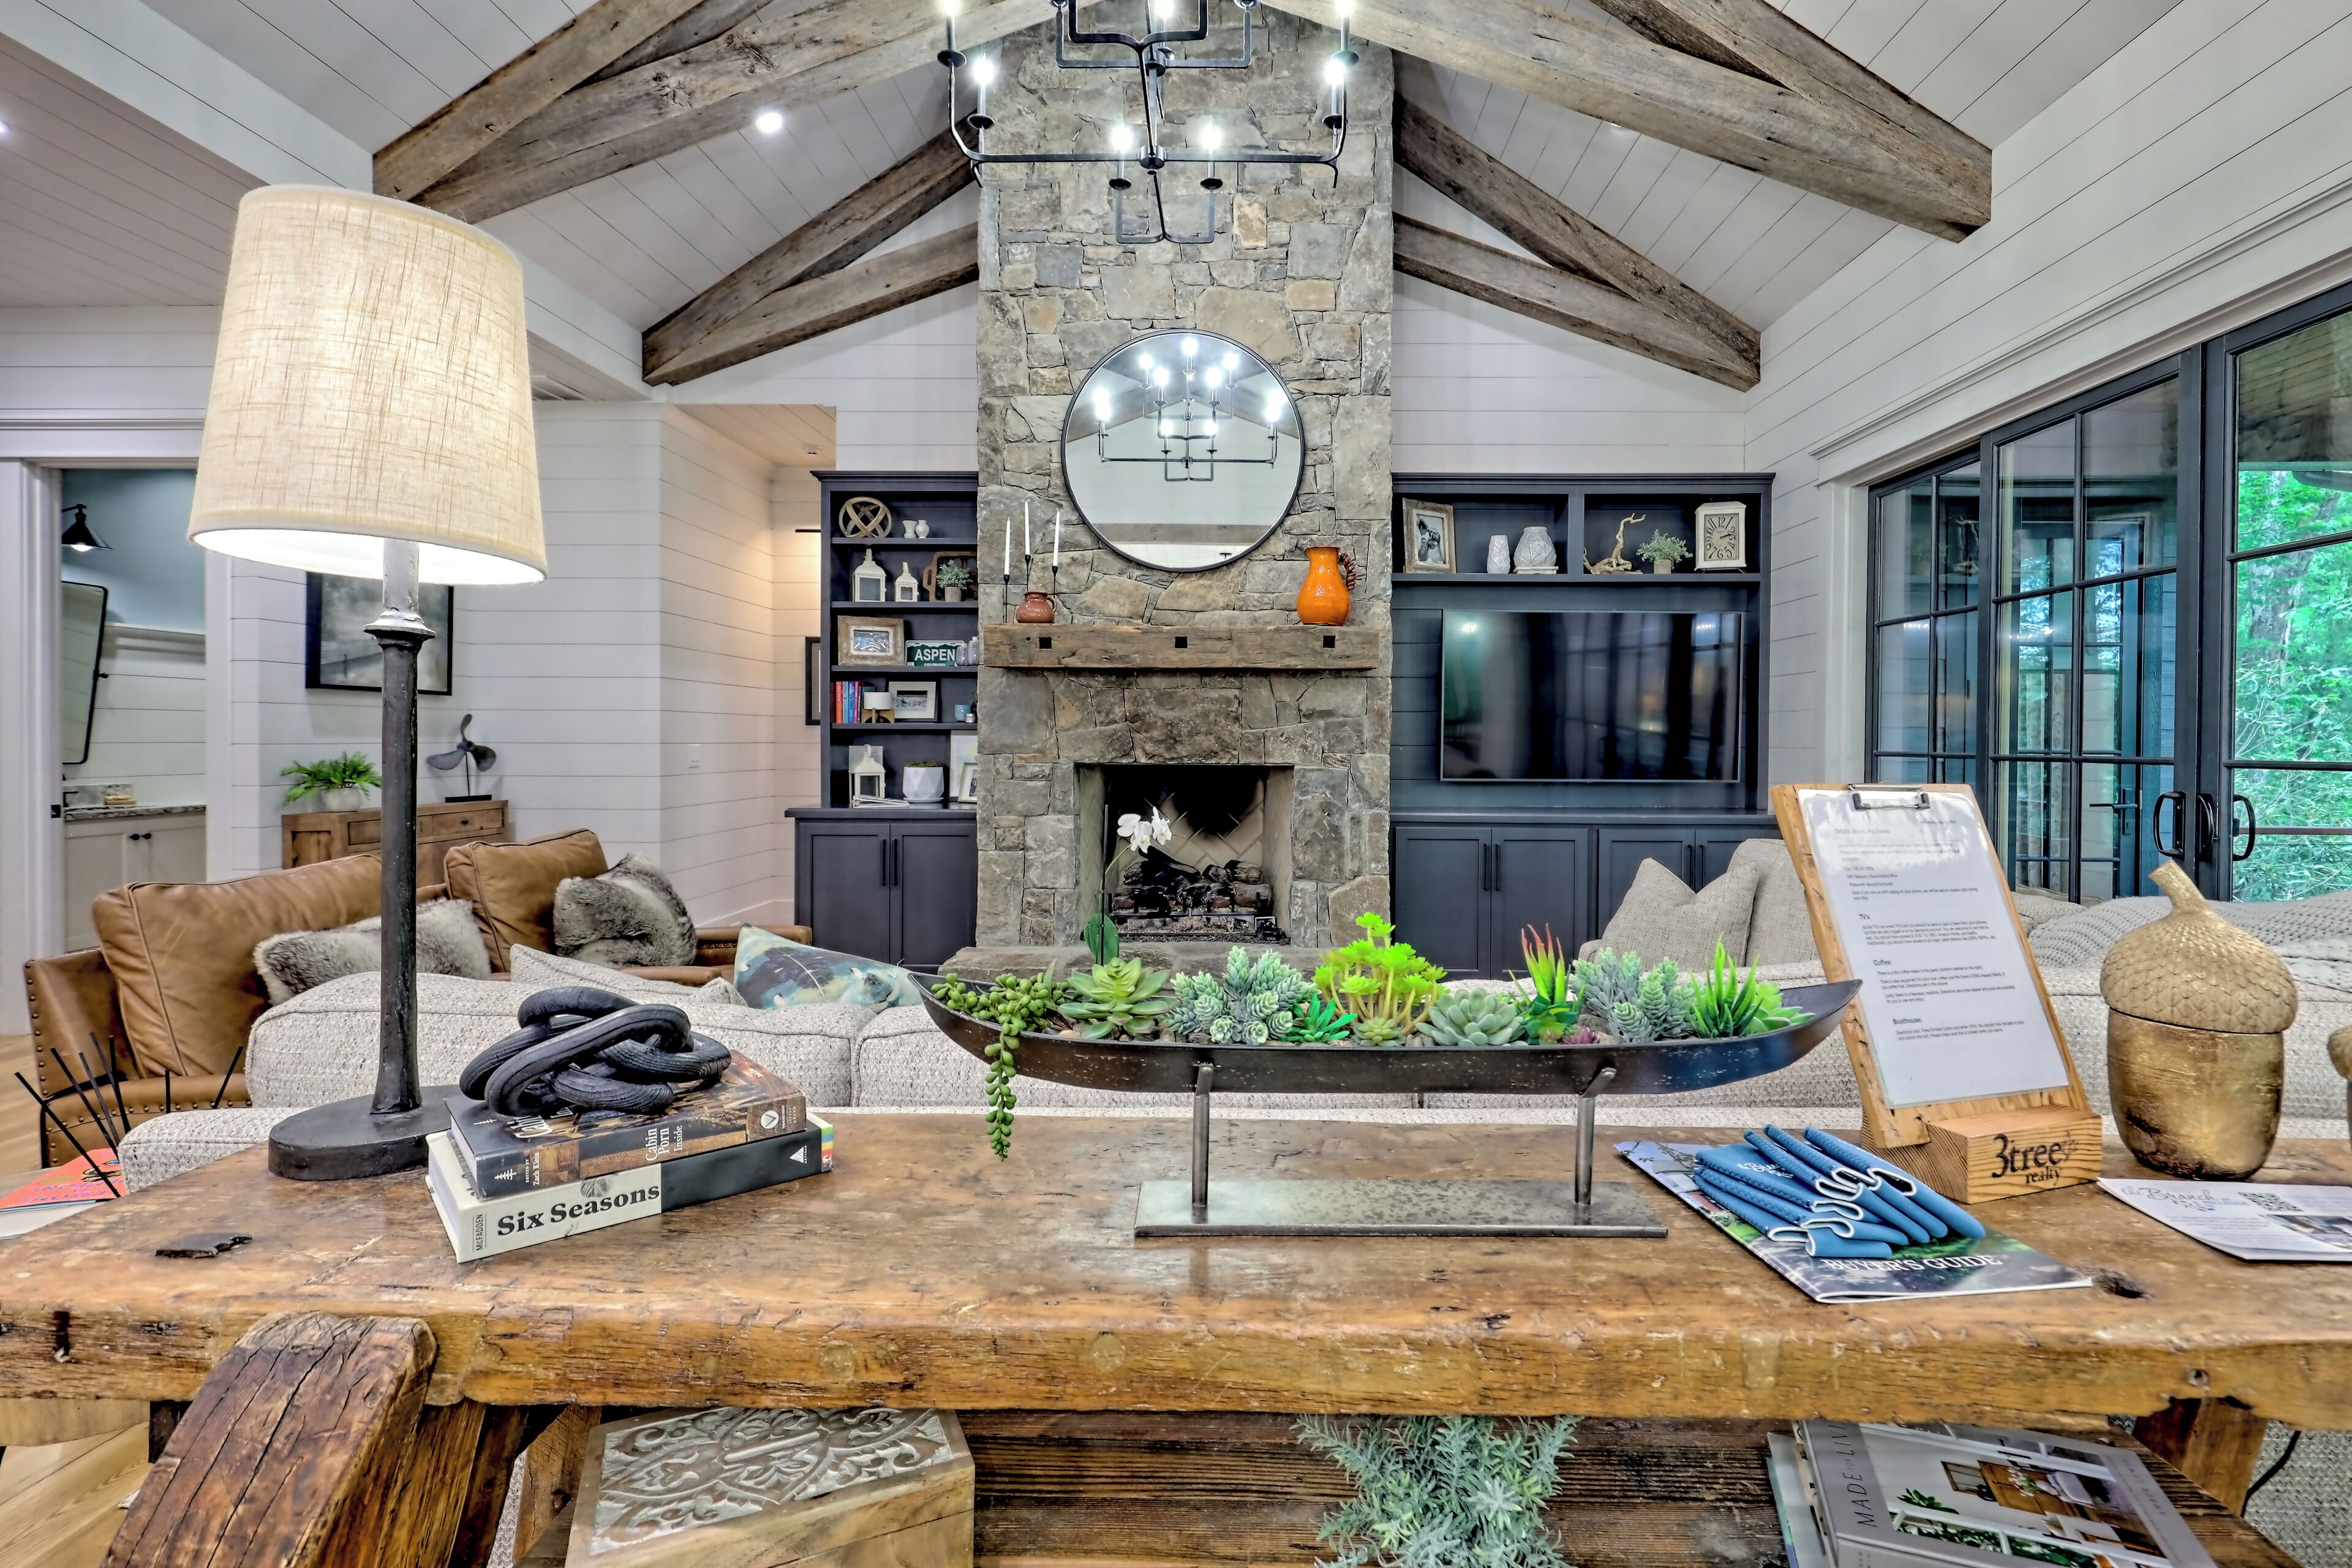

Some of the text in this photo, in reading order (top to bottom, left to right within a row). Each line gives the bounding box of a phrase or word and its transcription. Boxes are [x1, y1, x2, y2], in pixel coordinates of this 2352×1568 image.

[1718, 516, 1725, 527] 12
[1706, 542, 1714, 551] 8
[1708, 546, 1717, 559] 7
[1717, 549, 1724, 559] 6
[1724, 546, 1732, 558] 5
[914, 649, 956, 661] ASPEN
[645, 1128, 658, 1161] Cabin
[658, 1127, 670, 1156] Porn
[673, 1125, 683, 1152] Inside
[2026, 1166, 2060, 1185] realty
[2138, 1187, 2217, 1202] Branch
[497, 1186, 660, 1236] Six Seasons
[1820, 1255, 2003, 1272] BUYER'S GUIDE
[1828, 1425, 1855, 1455] LIVI
[1842, 1472, 1877, 1528] MADE
